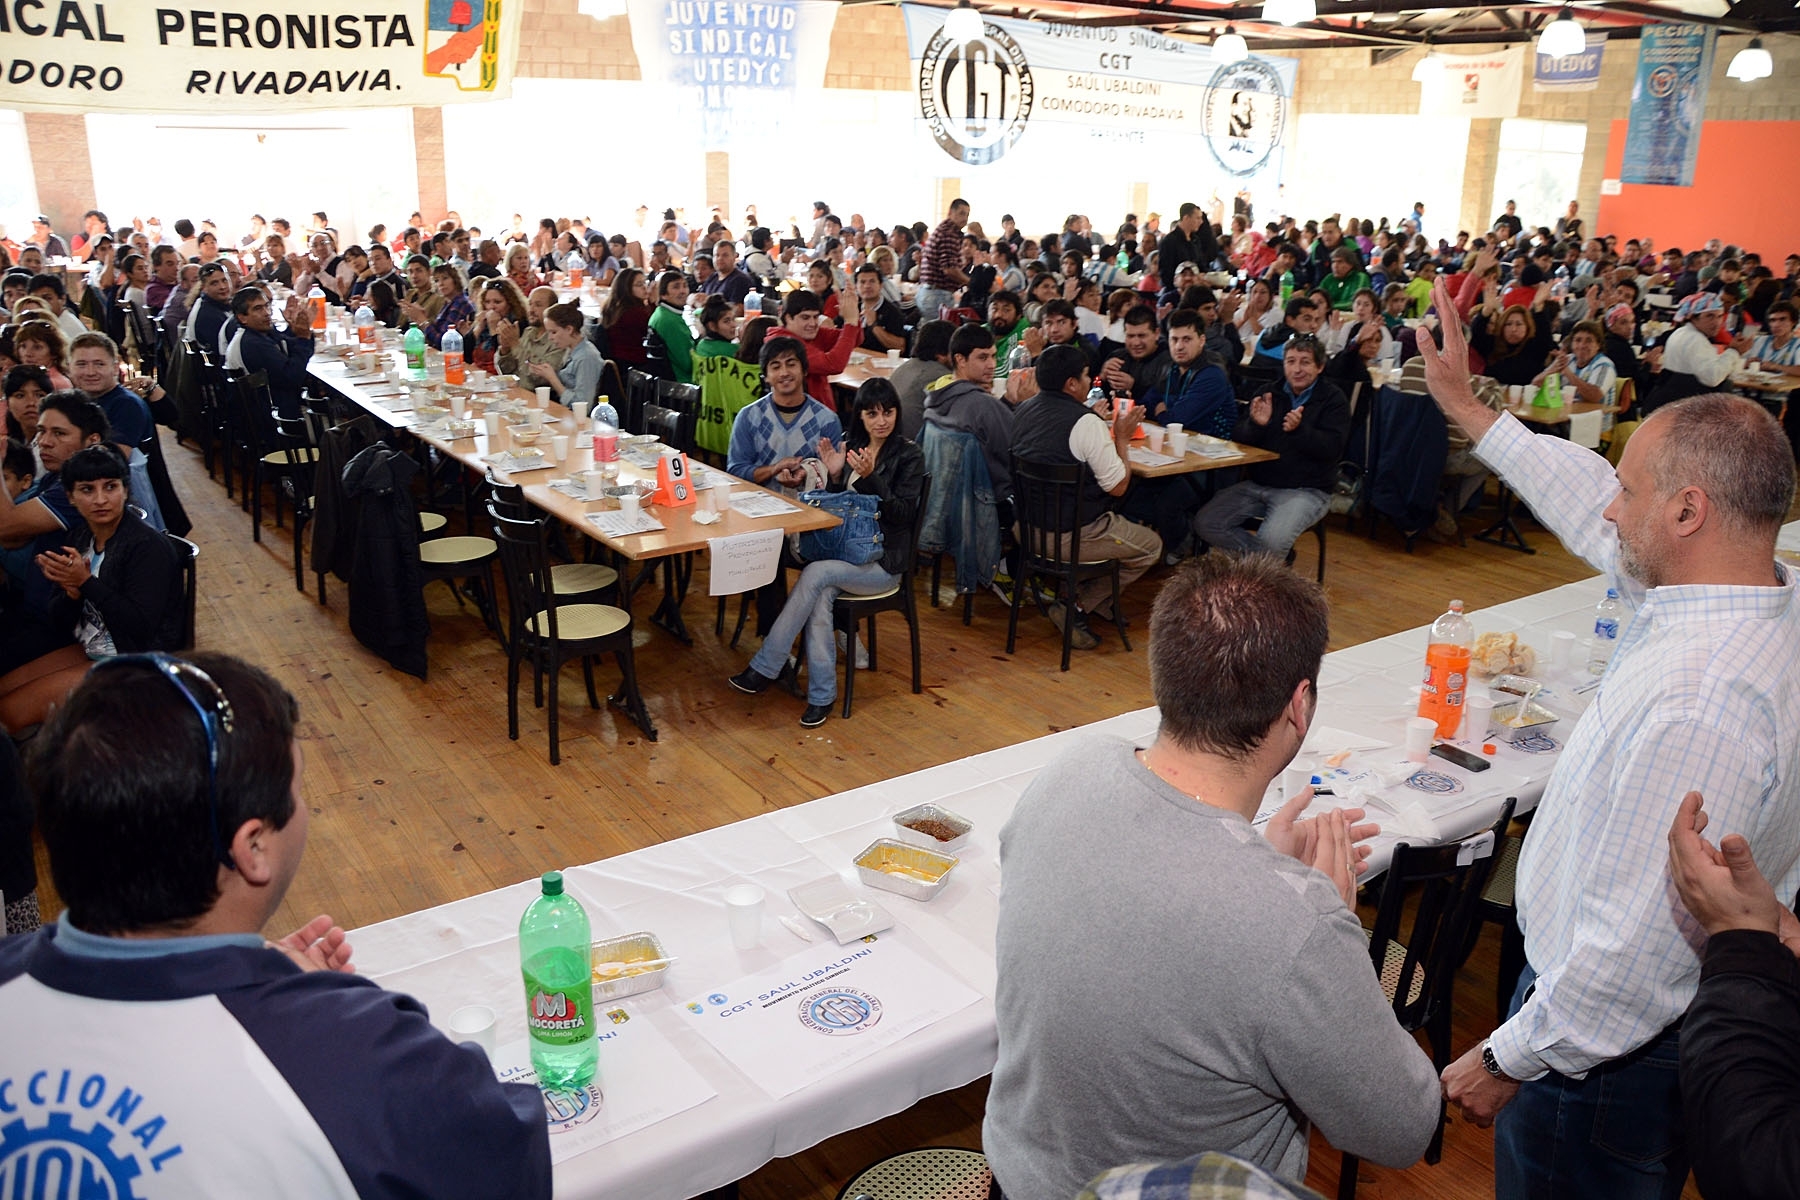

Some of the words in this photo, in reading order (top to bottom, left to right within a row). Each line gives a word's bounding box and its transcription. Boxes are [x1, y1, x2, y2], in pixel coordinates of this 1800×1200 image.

[156, 7, 415, 49] PERONISTA
[665, 0, 797, 31] JUVENTUD
[669, 28, 792, 60] SINDICAL
[1043, 22, 1119, 43] JUVENTUD
[1129, 31, 1185, 53] SINDICAL
[693, 57, 781, 85] UTEDYC
[1099, 52, 1132, 71] CGT
[1541, 54, 1597, 74] UTEDYC
[0, 59, 124, 91] DORO
[186, 69, 402, 95] RIVADAVIA.
[1066, 72, 1100, 91] SAÚL
[1103, 79, 1162, 96] UBALDINI
[1041, 96, 1120, 117] COMODORO
[1123, 104, 1185, 120] RIVADAVIA
[672, 457, 683, 477] 9
[720, 999, 753, 1019] CGT
[758, 981, 802, 1001] SAUL
[802, 948, 873, 982] UBALDINI
[536, 990, 567, 1018] M
[762, 989, 801, 1009] MOVIMIENTO
[809, 988, 843, 1001] GENERAL
[844, 988, 859, 996] DEL
[860, 992, 881, 1012] TRABAJO
[528, 1014, 585, 1031] MOCORETÁ
[0, 1068, 183, 1173] CCIONAL
